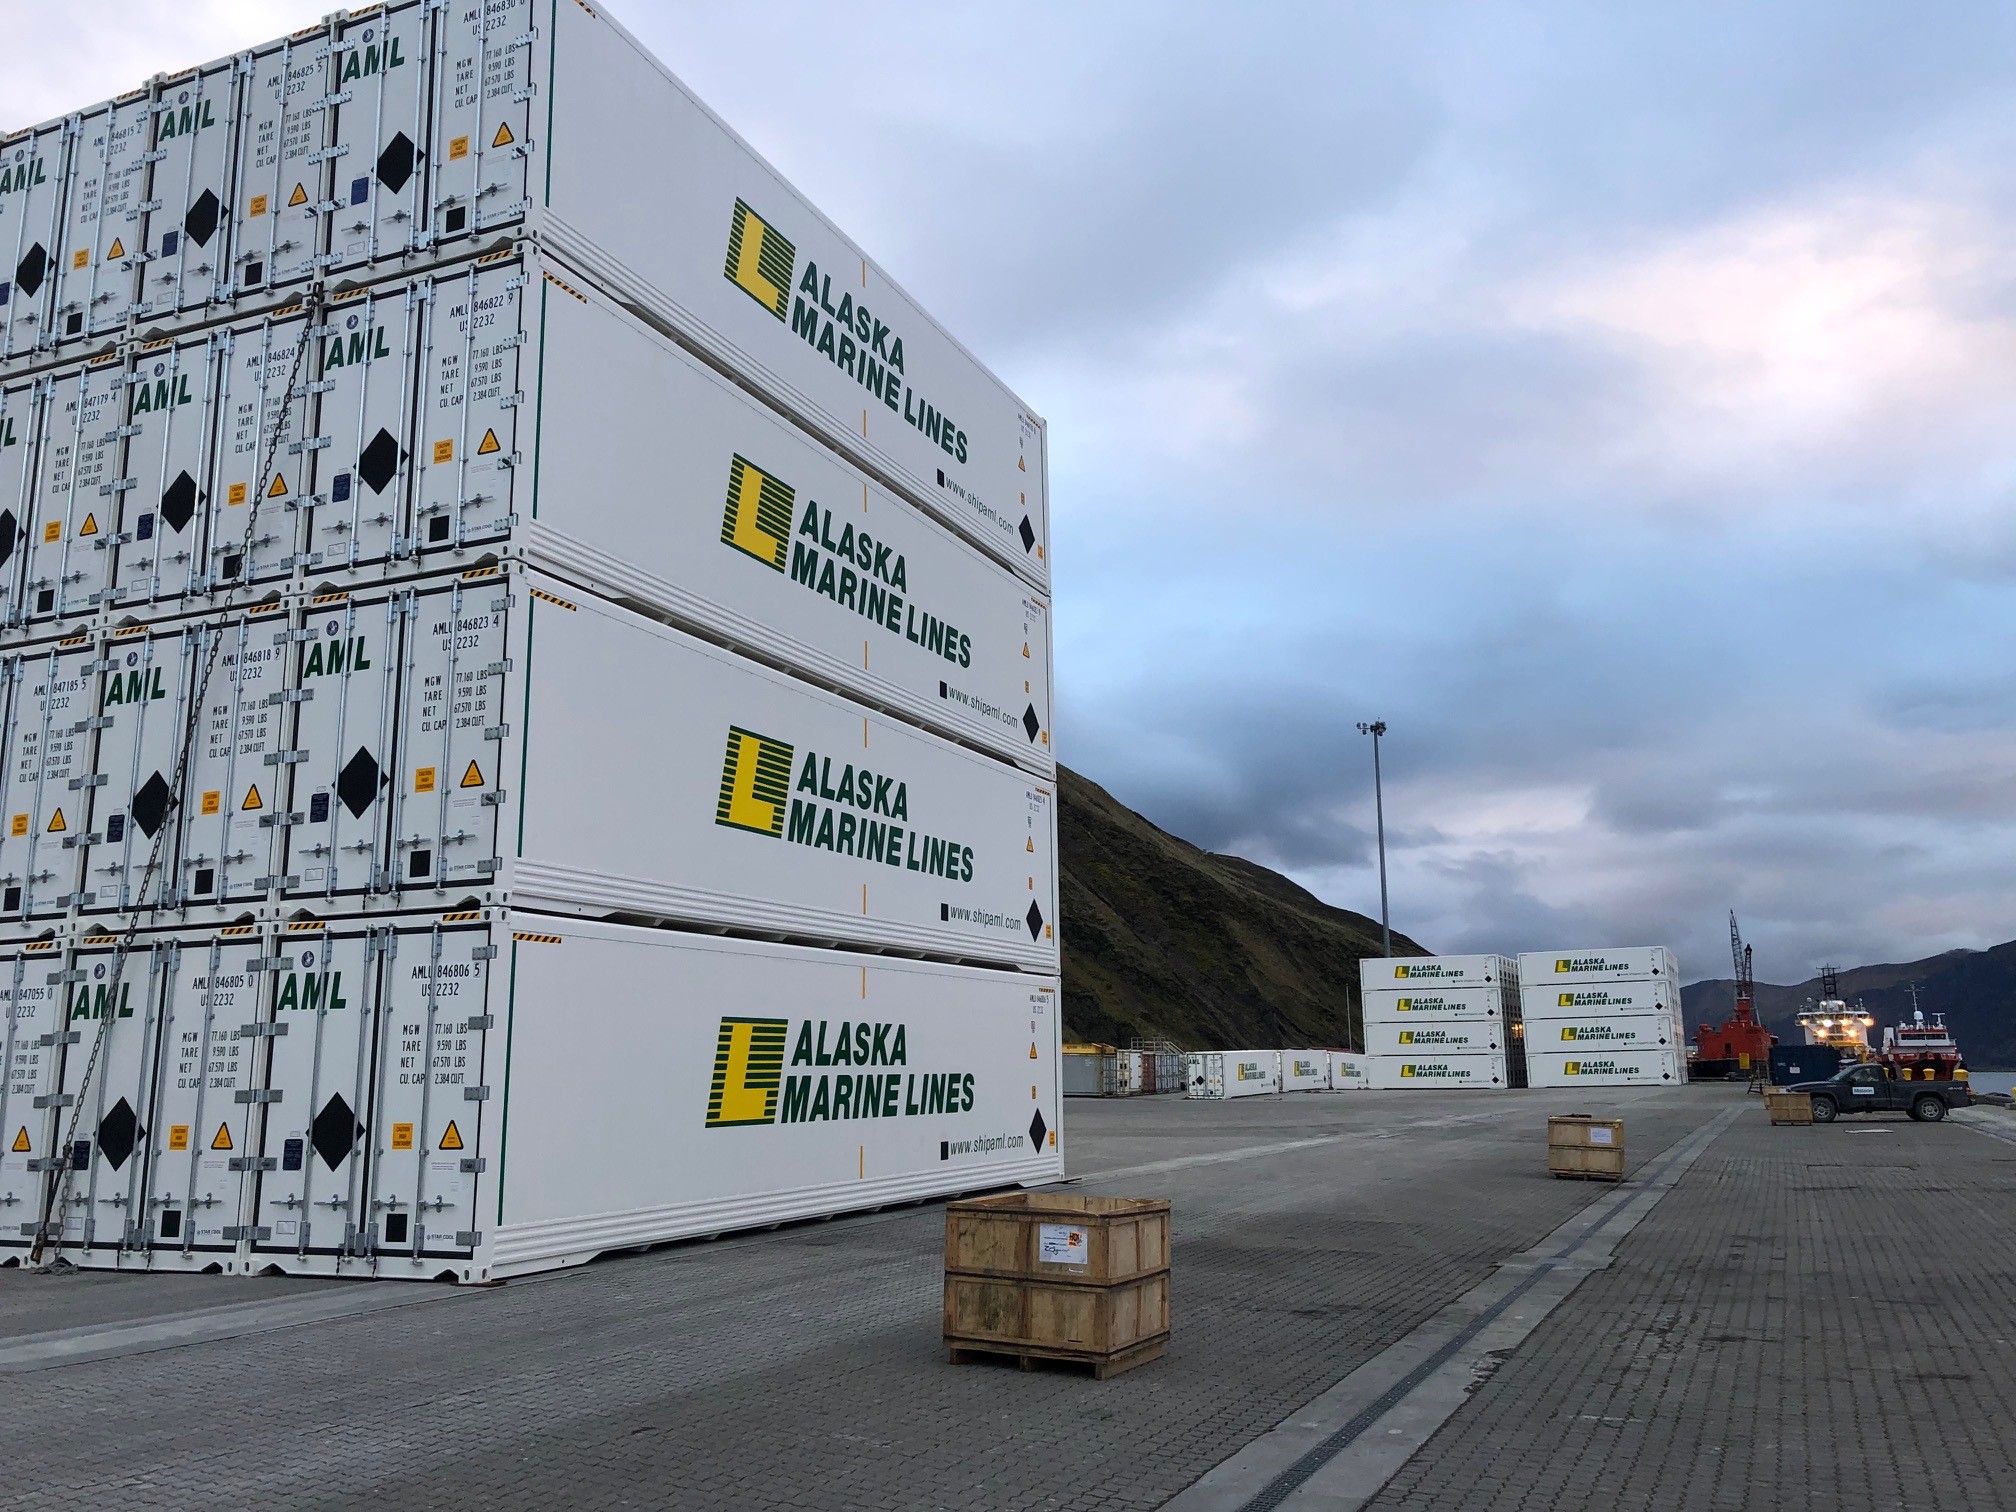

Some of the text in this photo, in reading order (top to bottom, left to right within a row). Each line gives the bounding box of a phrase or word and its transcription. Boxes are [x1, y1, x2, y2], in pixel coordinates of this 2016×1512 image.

[486, 0, 515, 15] 846830
[486, 15, 506, 31] 2232
[342, 37, 405, 83] AML
[457, 58, 472, 70] MGW
[506, 44, 515, 54] LBS
[288, 62, 322, 81] 846825 5
[457, 70, 473, 82] TARE
[505, 57, 515, 67] LBS
[287, 81, 305, 95] 2232
[455, 84, 468, 95] NET
[504, 70, 514, 81] LBS
[159, 99, 215, 142] AML
[110, 142, 126, 155] 2232
[474, 295, 503, 312] 846822
[509, 293, 513, 303] 9
[474, 314, 494, 329] 2232
[800, 261, 904, 376] ALASKA
[268, 347, 295, 363] 846824
[325, 326, 390, 371] AML
[442, 355, 458, 367] MGW
[493, 345, 503, 355] LBS
[267, 365, 286, 378] 2232
[442, 368, 459, 380] TARE
[492, 359, 502, 369] LBS
[440, 383, 453, 394] NET
[491, 373, 501, 383] LBS
[792, 295, 968, 464] MARINE LINES
[84, 392, 116, 408] 847179 4
[133, 374, 192, 415] AML
[83, 410, 100, 423] 2232
[946, 477, 1014, 535] www.shipaml.com
[799, 500, 907, 593] ALASKA
[791, 540, 971, 668] MARINE LINES
[457, 616, 488, 631] 846823
[493, 615, 499, 627] 4
[457, 635, 478, 649] 2232
[244, 648, 279, 663] 846818 9
[303, 636, 370, 678] AML
[243, 667, 262, 680] 2232
[425, 675, 441, 687] MGW
[477, 670, 487, 680] LBS
[53, 679, 86, 693] 847185 5
[105, 666, 165, 706] AML
[424, 690, 442, 702] TARE
[476, 685, 486, 695] LBS
[52, 697, 69, 709] 2232
[423, 706, 436, 717] NET
[475, 701, 485, 711] LBS
[949, 686, 1017, 728] www.shipaml.com
[797, 752, 907, 822] ALASKA
[787, 799, 974, 883] MARINE LINES
[951, 906, 1021, 930] www.shipaml.com
[437, 964, 469, 978] 846806
[475, 964, 480, 976] 5
[215, 975, 243, 988] 846805
[437, 983, 459, 996] 2232
[19, 988, 44, 1000] 847055
[277, 971, 346, 1010] AML
[214, 993, 234, 1006] 2232
[17, 1006, 35, 1018] 2232
[182, 1032, 198, 1042] MGW
[403, 1025, 420, 1035] MGW
[457, 1023, 467, 1034] LBS
[181, 1047, 198, 1057] TARE
[402, 1041, 421, 1051] TARE
[456, 1040, 466, 1050] LBS
[791, 1021, 906, 1066] ALASKA
[179, 1063, 192, 1073] NET
[401, 1057, 414, 1068] NET
[455, 1057, 465, 1067] LBS
[781, 1072, 975, 1124] MARINE LINES
[950, 1133, 1023, 1155] www.shipaml.com
